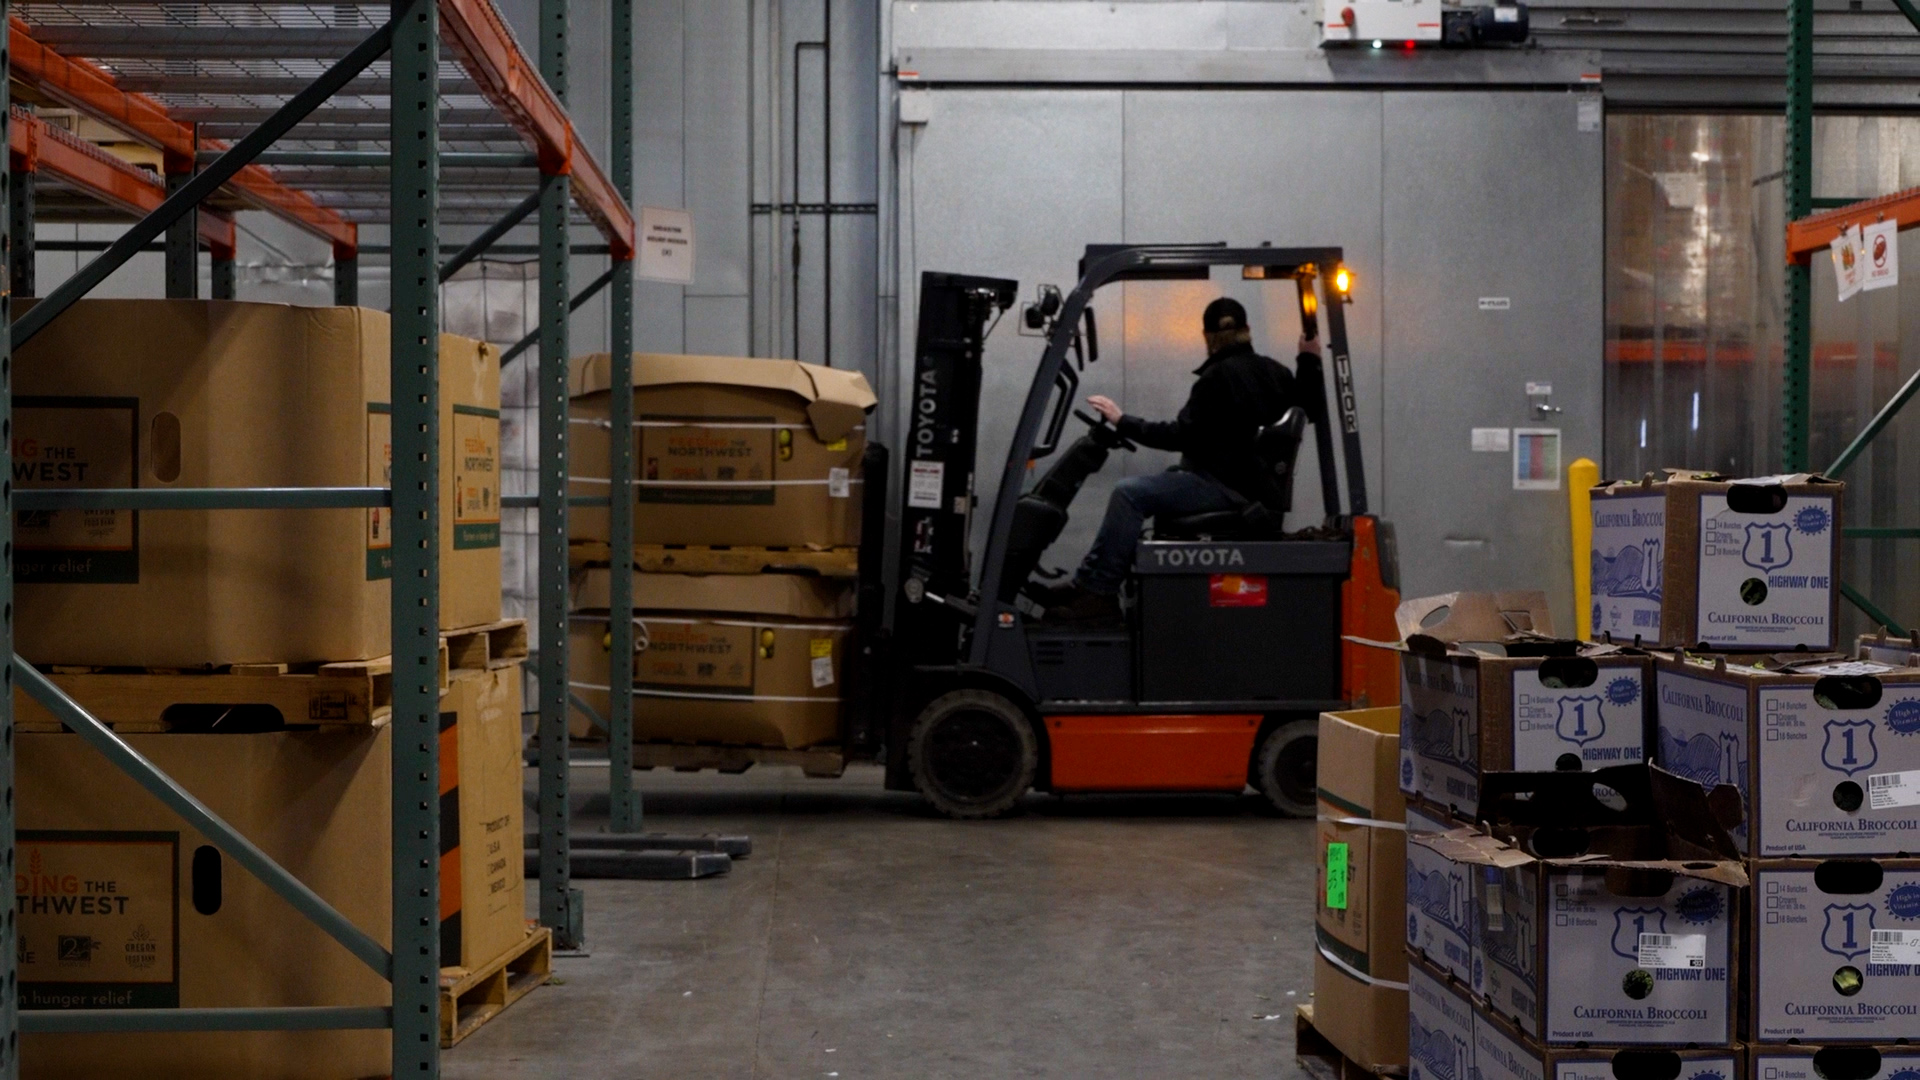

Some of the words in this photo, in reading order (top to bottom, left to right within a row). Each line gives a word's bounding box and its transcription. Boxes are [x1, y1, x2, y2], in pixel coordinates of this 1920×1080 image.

[1336, 355, 1356, 432] THOR
[915, 369, 937, 458] TOYOTA
[44, 447, 76, 459] THE
[668, 447, 752, 457] NORTHWEST
[1761, 530, 1775, 563] 1
[1153, 548, 1245, 566] TOYOTA
[52, 558, 92, 574] relief
[1768, 576, 1809, 589] HIGHWAY
[1810, 576, 1829, 589] ONE
[1708, 611, 1768, 624] CALIFORNIA
[1771, 613, 1824, 625] BROCCOLI
[649, 642, 732, 654] NORTHWEST
[1662, 684, 1703, 713] CALIFORNIA
[1704, 693, 1744, 723] BROCCOLI
[1574, 703, 1588, 736] 1
[1786, 732, 1807, 740] Bunches
[1842, 728, 1857, 765] 1
[1582, 747, 1622, 761] HIGHWAY
[1624, 747, 1642, 760] ONE
[1786, 819, 1854, 832] CALIFORNIA
[1858, 818, 1917, 831] BROCCOLI
[84, 881, 117, 893] THE
[1786, 885, 1808, 893] Bunches
[1896, 893, 1912, 902] High
[1576, 918, 1597, 926] Bunches
[1786, 915, 1808, 923] Bunches
[1842, 912, 1858, 949] 1
[1656, 968, 1702, 981] HIGHWAY
[1705, 968, 1725, 981] ONE
[1866, 964, 1911, 977] HIGHWAY
[33, 991, 87, 1008] hunger
[93, 991, 132, 1005] relief
[1573, 1006, 1643, 1019] CALIFORNIA
[1647, 1007, 1707, 1019] BROCCOLI
[1785, 1003, 1854, 1016] CALIFORNIA
[1857, 1003, 1917, 1015] BROCCOLI
